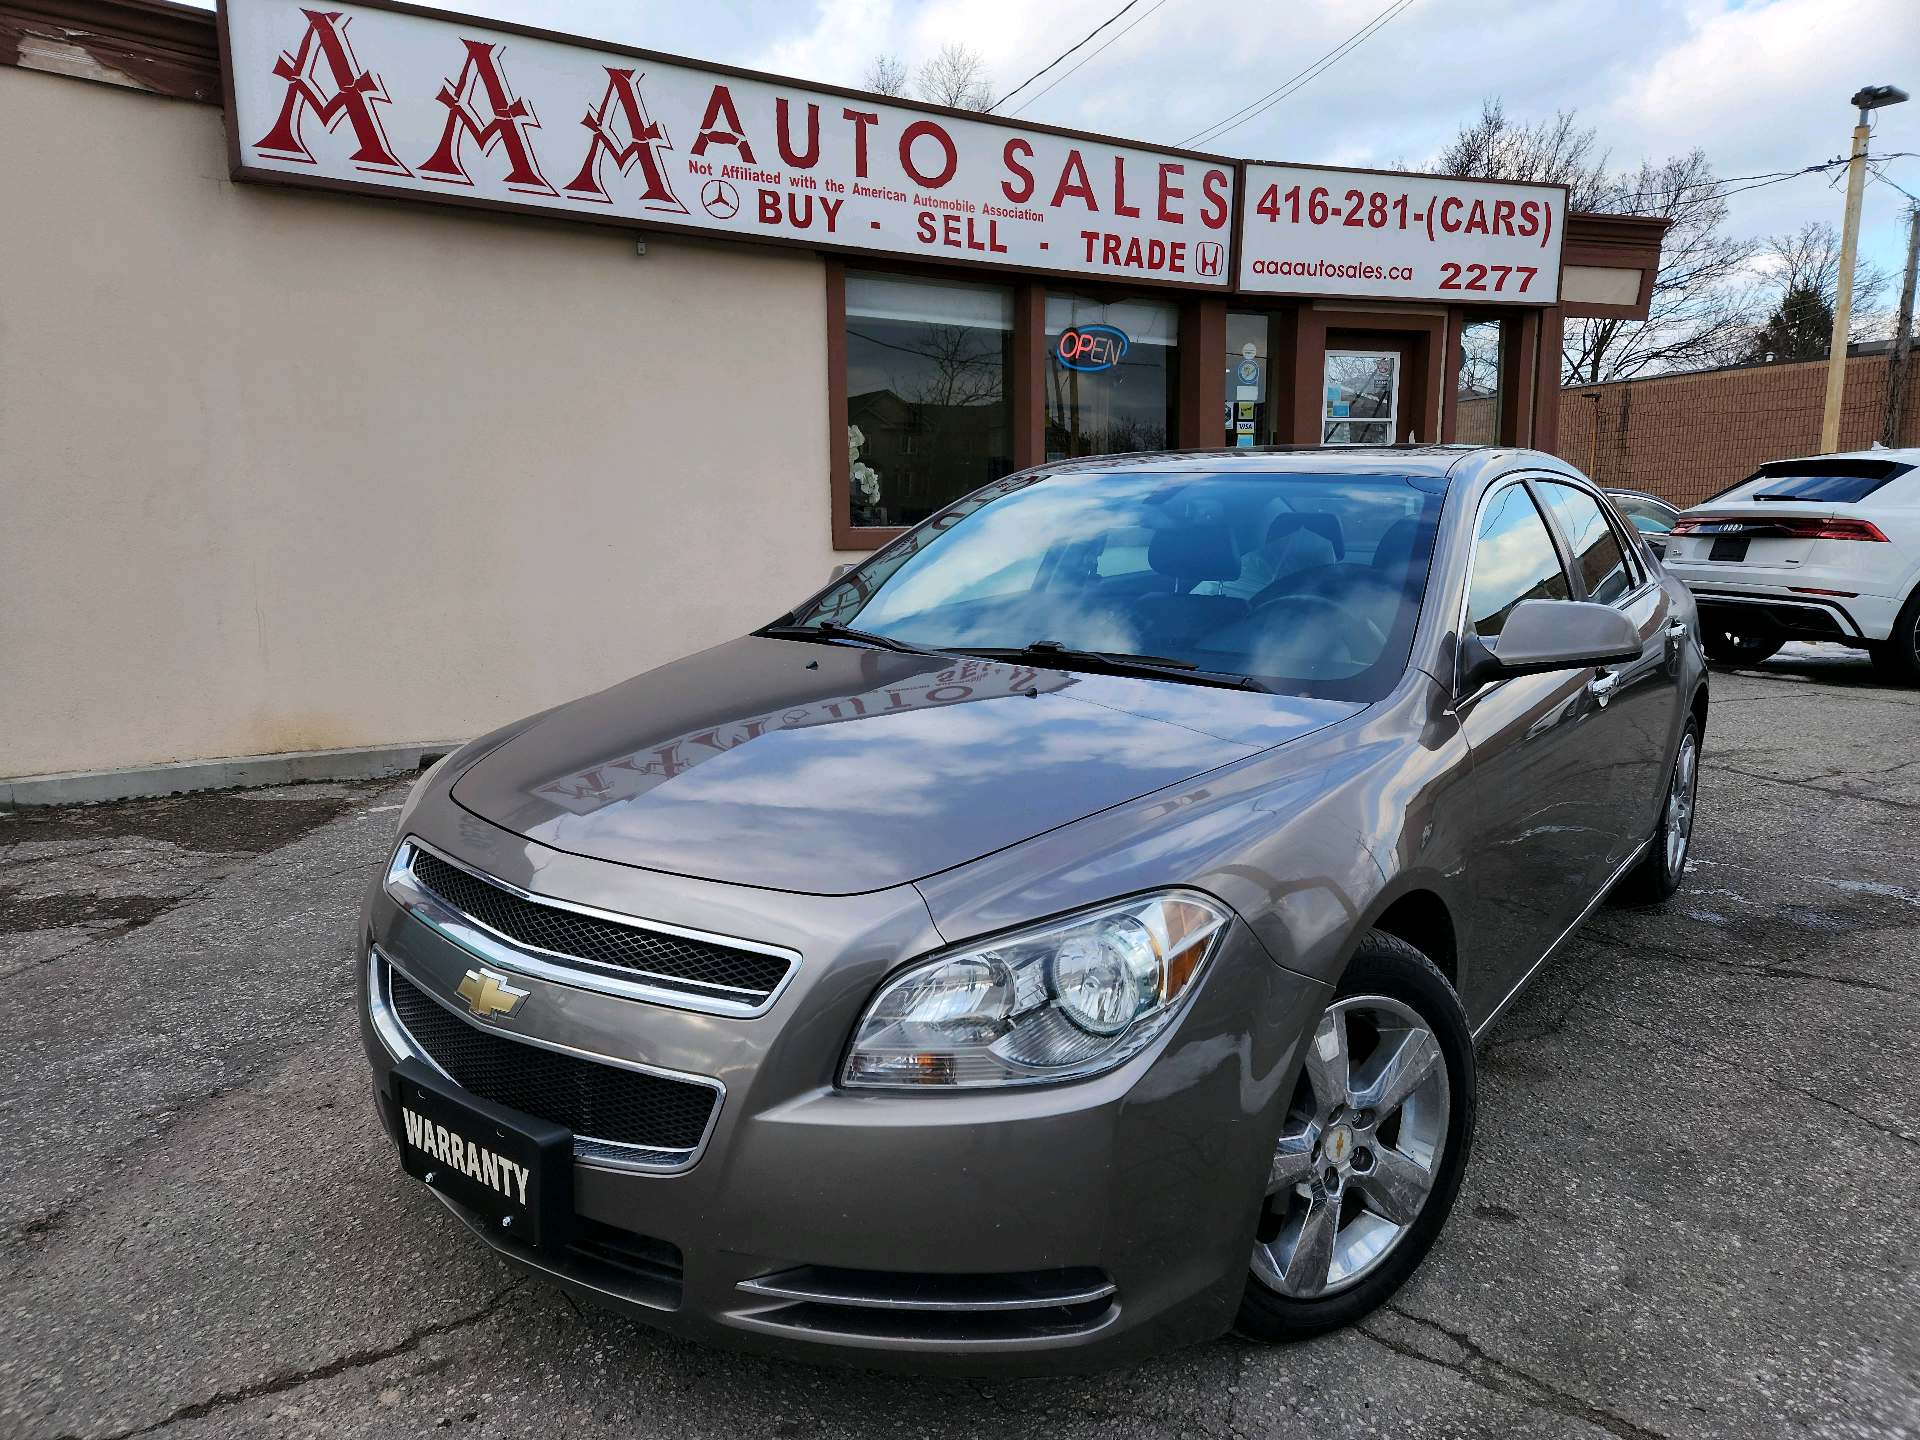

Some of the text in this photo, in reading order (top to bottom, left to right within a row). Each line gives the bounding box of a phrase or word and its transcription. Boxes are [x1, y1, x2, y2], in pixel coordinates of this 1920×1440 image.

[690, 85, 958, 189] AUTO
[1000, 138, 1229, 230] SALES
[688, 160, 1044, 222] Not Affiliated with the American Automobile Association
[1256, 183, 1552, 249] 416-281-(CARS)
[757, 188, 845, 233] BUY
[916, 211, 1008, 254] SELL
[1080, 230, 1187, 273] TRADE
[1252, 259, 1539, 293] aaaautosales.ca 2277
[1060, 331, 1123, 366] OPEN
[1238, 422, 1254, 431] VISA
[402, 1106, 530, 1206] WARRANTY
